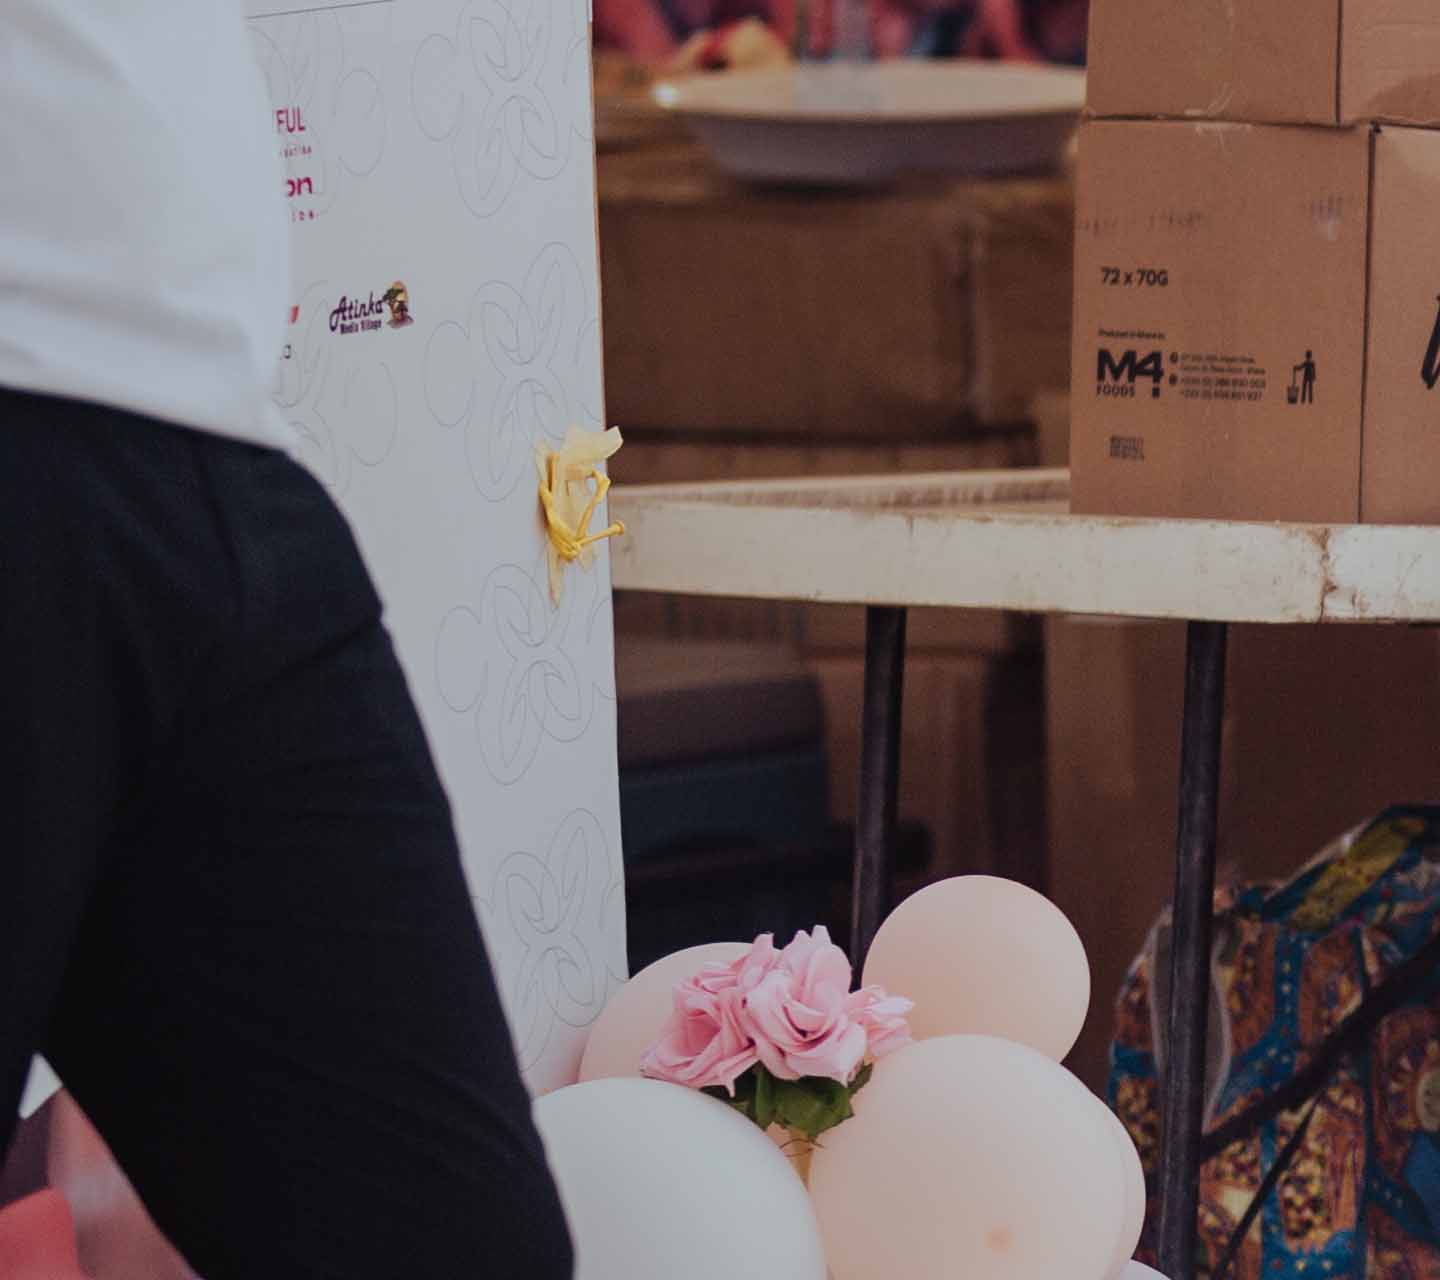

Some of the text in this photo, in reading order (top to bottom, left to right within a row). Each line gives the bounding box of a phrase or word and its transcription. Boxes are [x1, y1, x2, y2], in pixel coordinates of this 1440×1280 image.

[1101, 266, 1169, 287] 72 x 70G
[328, 291, 385, 332] Atinka
[1096, 348, 1165, 384] M4
[1095, 383, 1136, 399] FOODS
